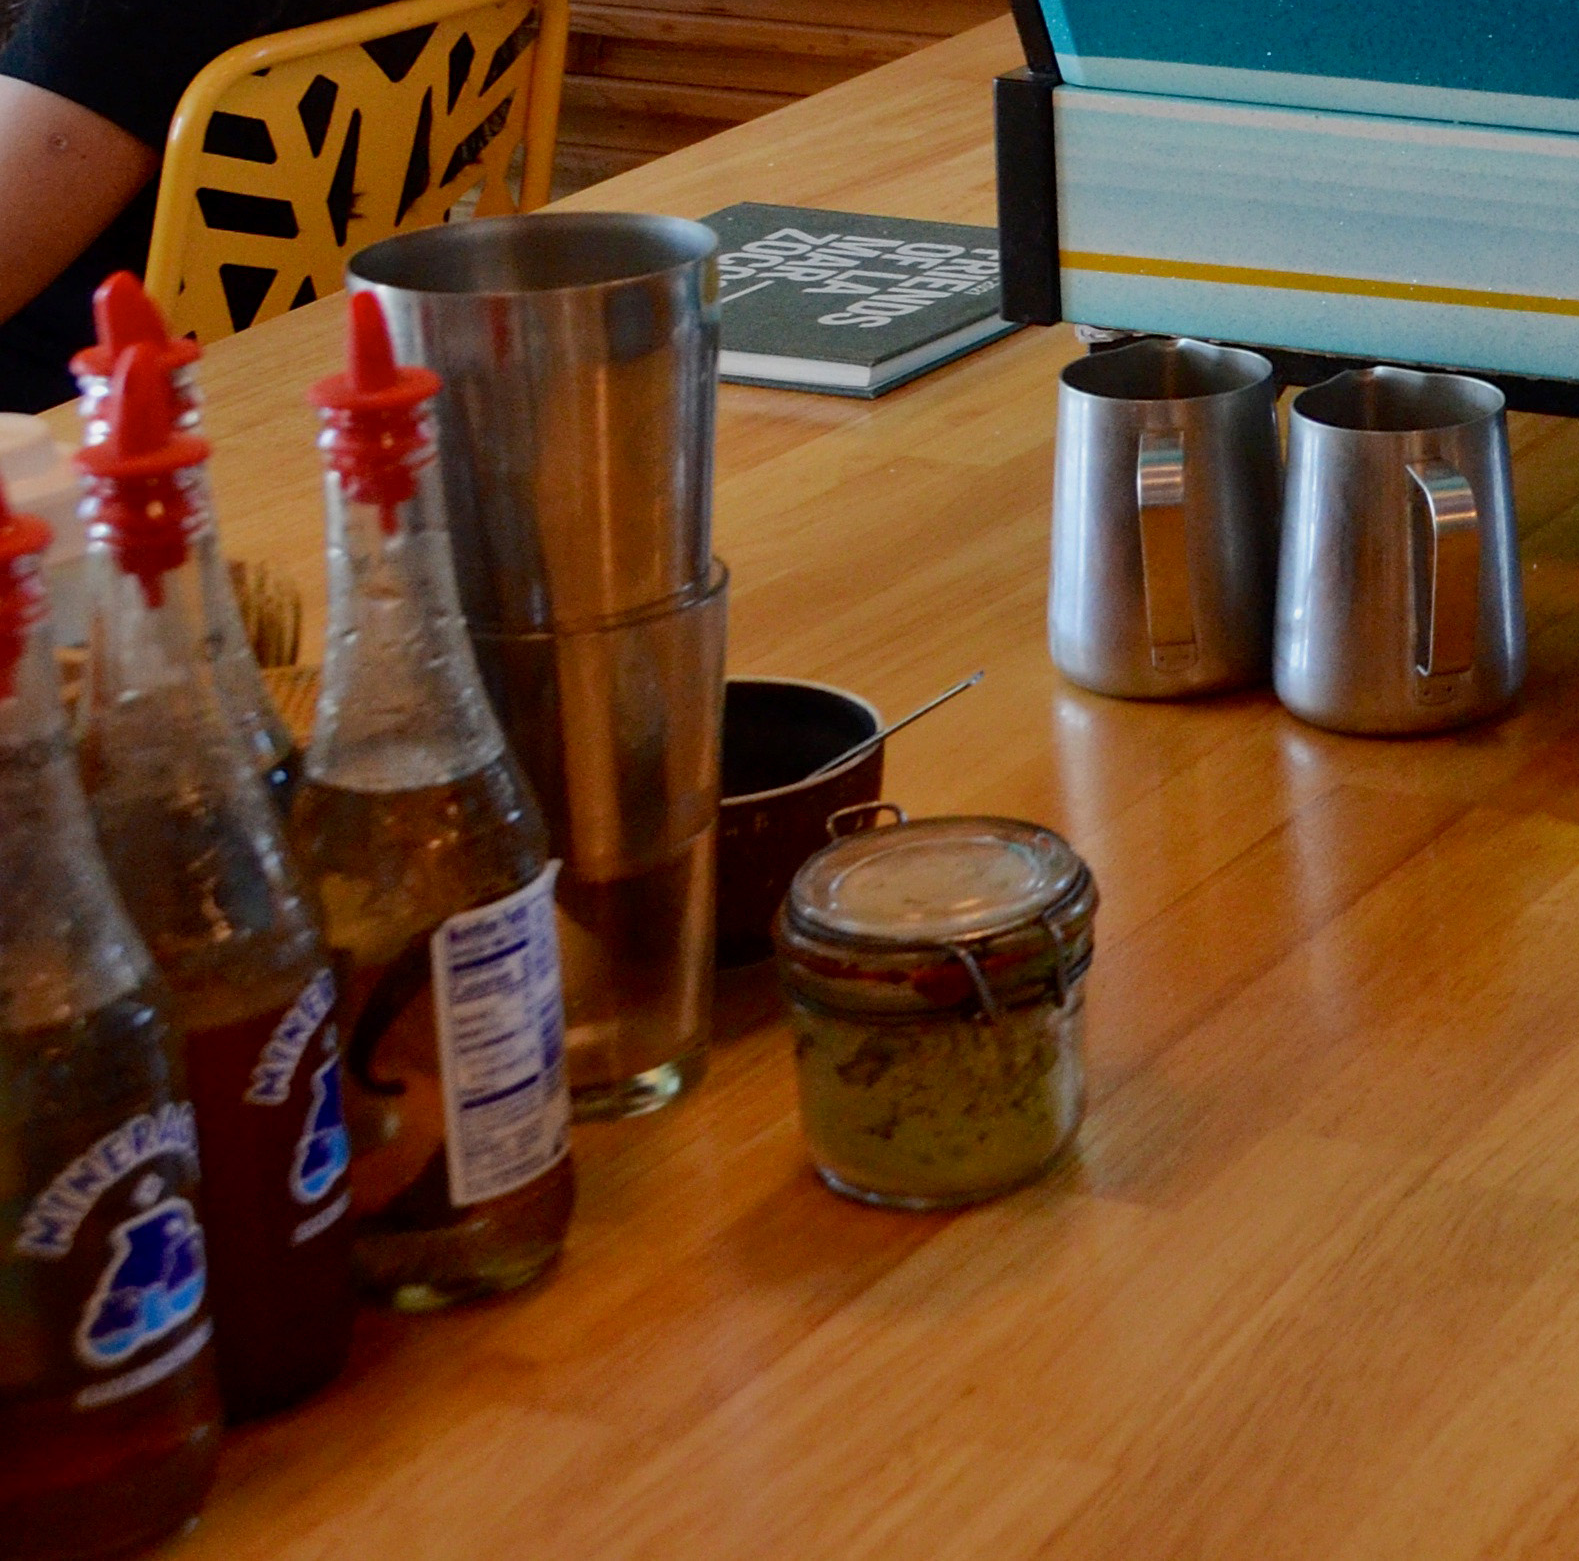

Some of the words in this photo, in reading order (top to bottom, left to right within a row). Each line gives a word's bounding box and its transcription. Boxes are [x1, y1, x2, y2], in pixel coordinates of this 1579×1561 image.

[719, 228, 841, 288] ZOCC
[880, 242, 965, 269] OF
[801, 270, 911, 295] LA
